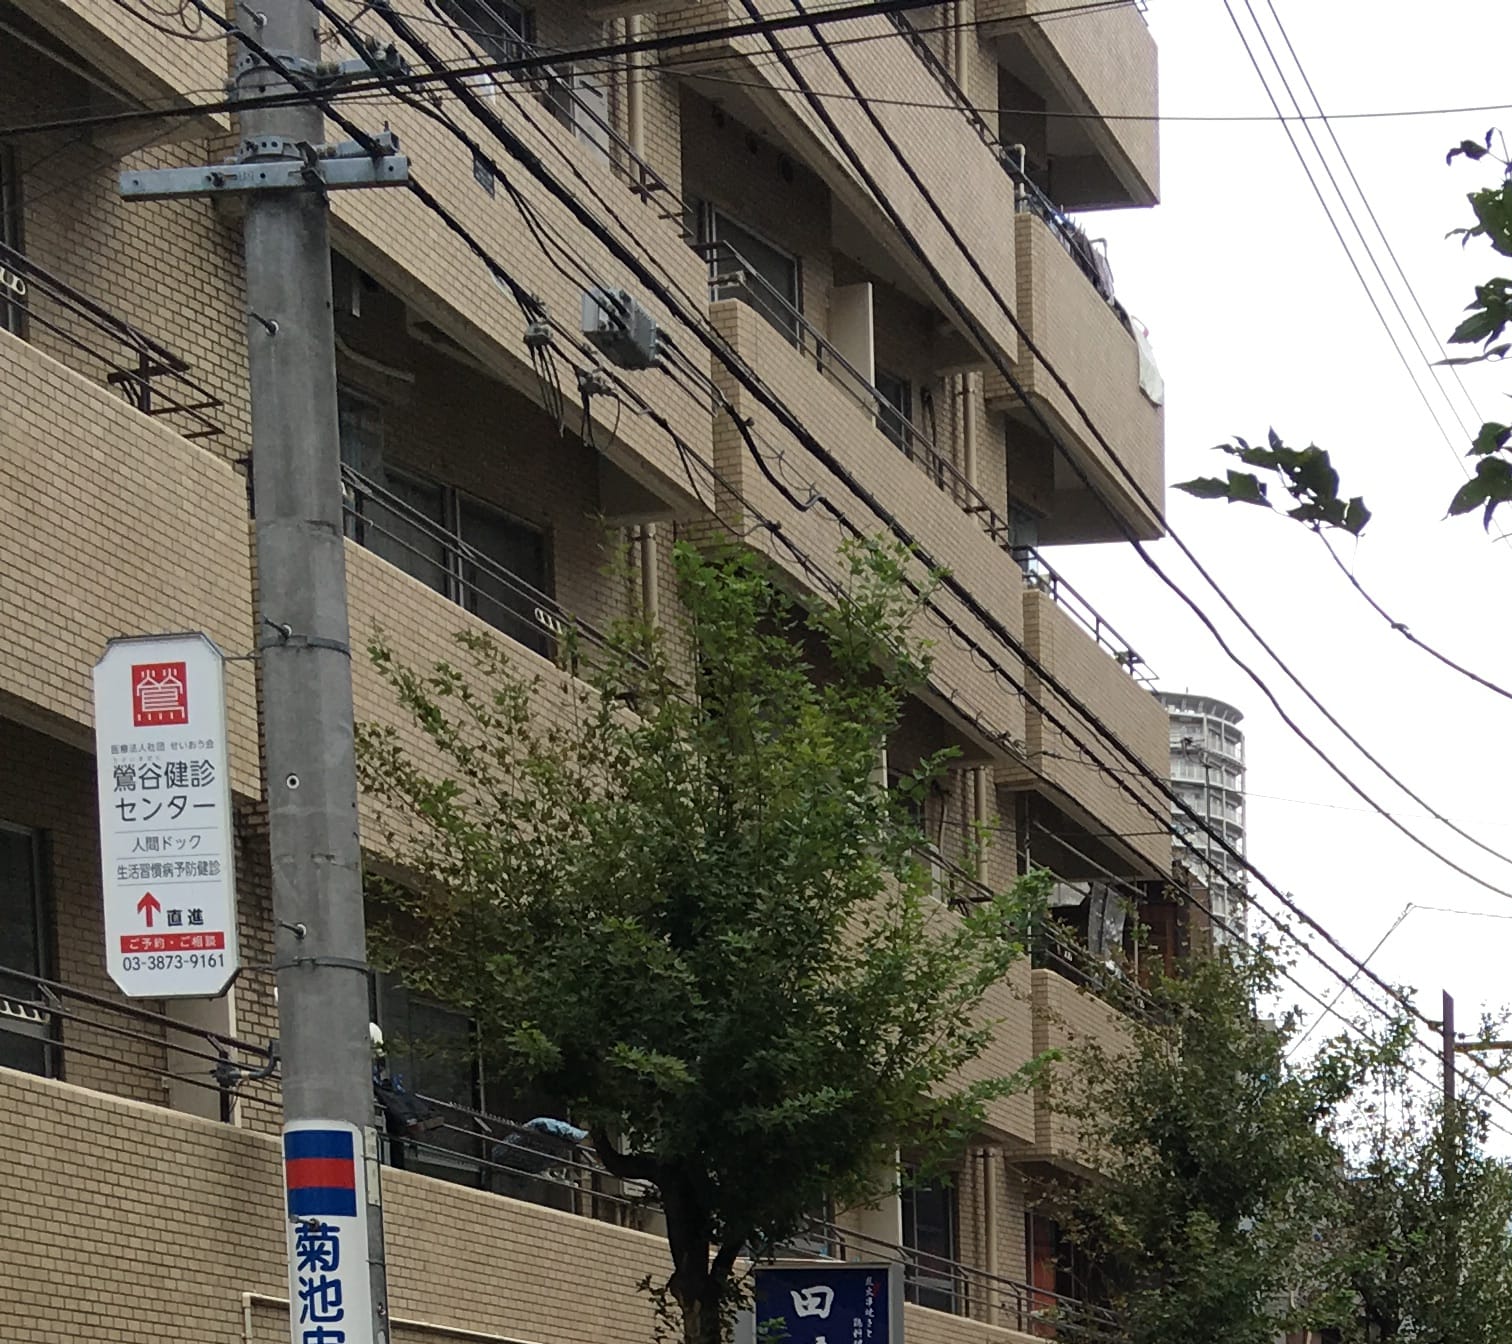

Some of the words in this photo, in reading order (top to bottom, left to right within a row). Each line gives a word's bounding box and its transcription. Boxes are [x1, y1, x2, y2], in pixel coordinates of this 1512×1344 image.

[113, 759, 216, 792] 鶯谷健診
[115, 795, 216, 822] センター
[132, 834, 201, 853] 人間ドック
[117, 859, 221, 881] 生活習慣病予防健診
[122, 953, 225, 972] 03-3873-9161
